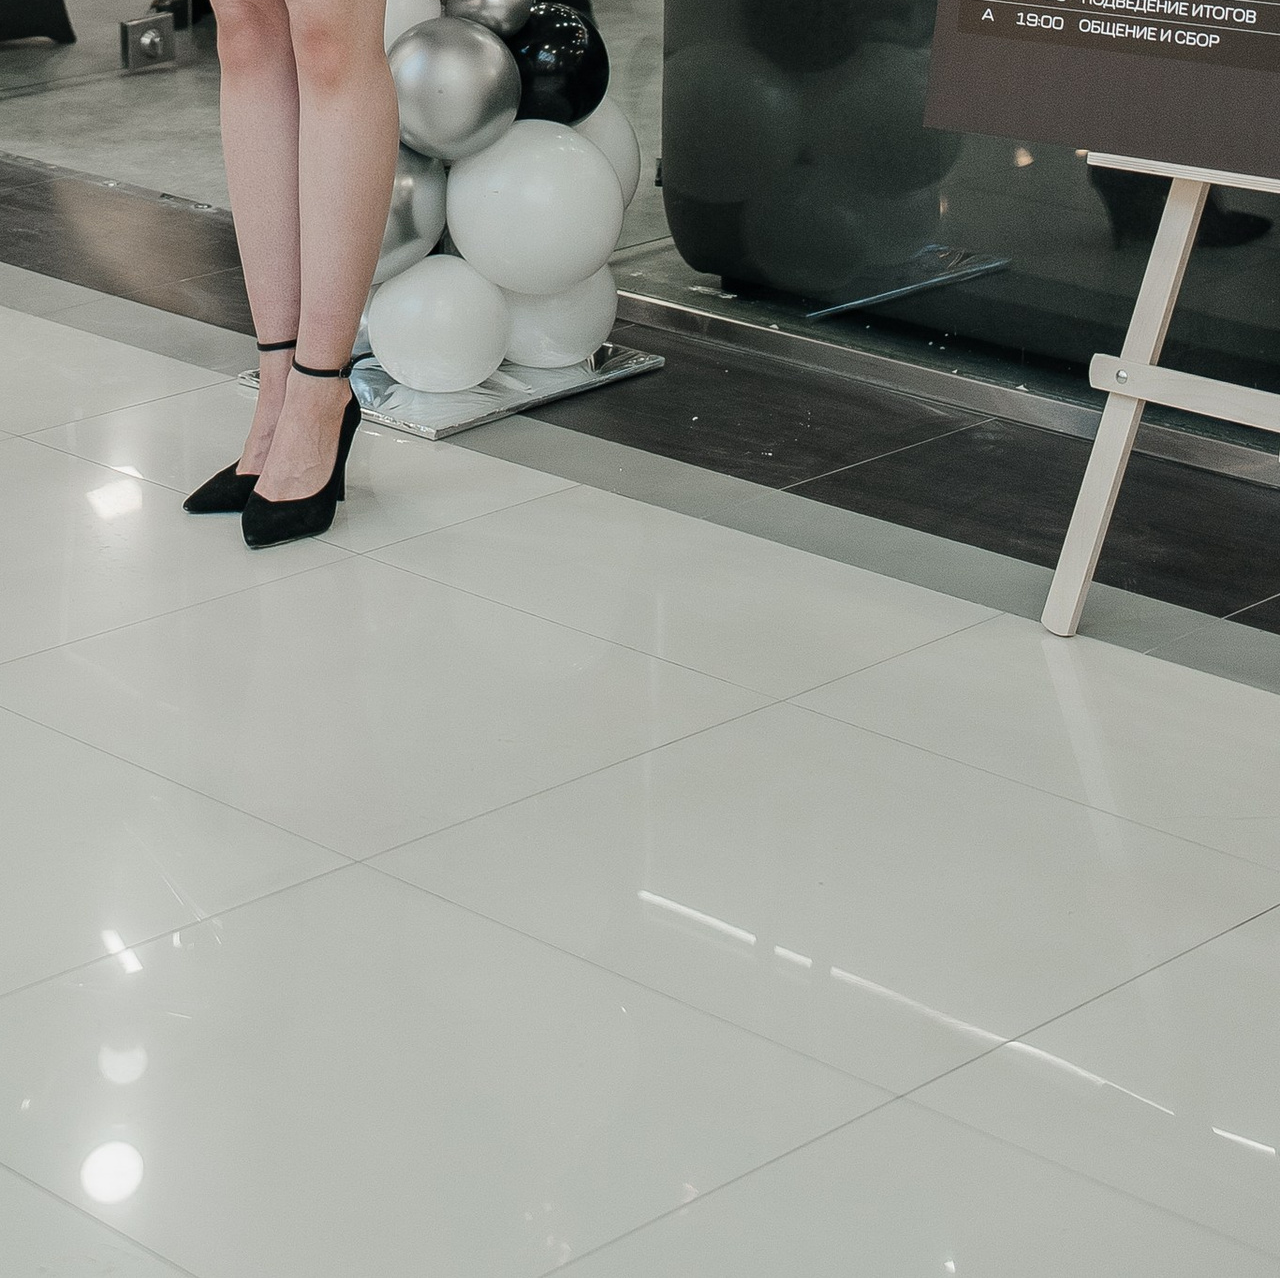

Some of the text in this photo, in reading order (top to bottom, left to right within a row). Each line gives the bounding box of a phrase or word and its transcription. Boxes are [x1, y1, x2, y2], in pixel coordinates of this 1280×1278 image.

[1191, 4, 1257, 24] ИТОГОВ
[1016, 12, 1064, 30] 19:00
[1078, 18, 1157, 41] ОБЩЕНИЕ
[1159, 28, 1172, 42] И
[1174, 30, 1220, 48] СБОР
